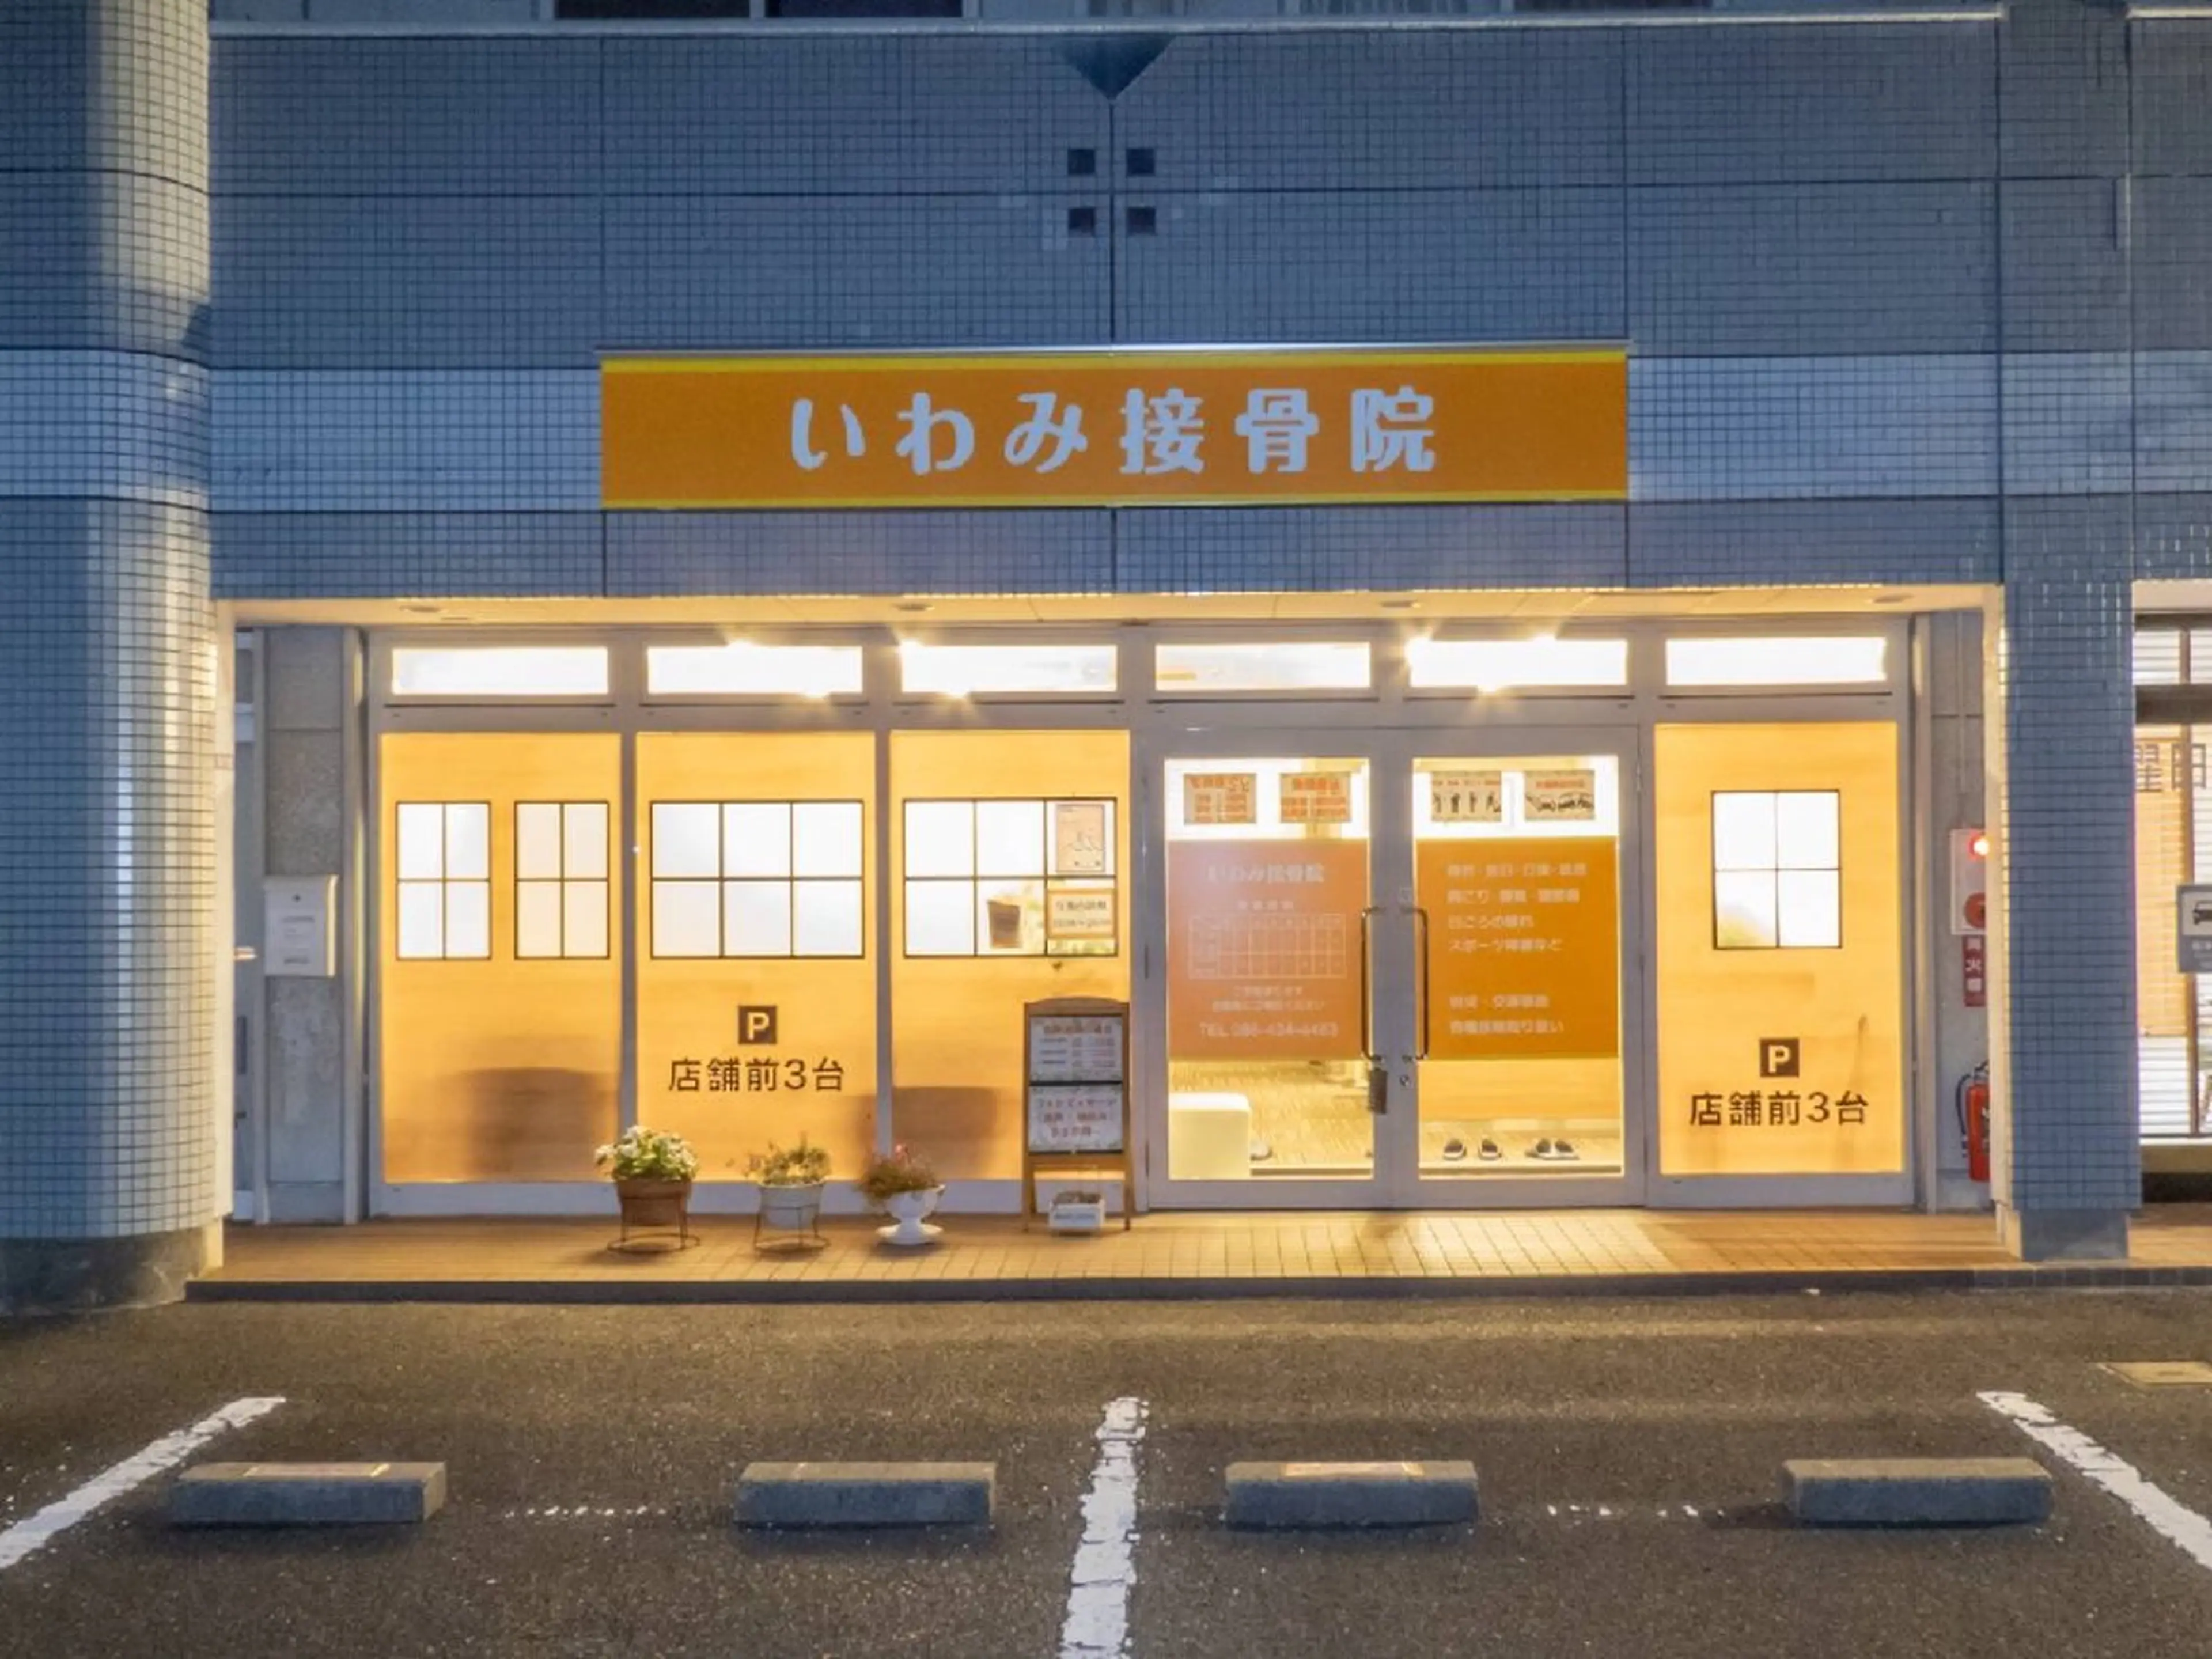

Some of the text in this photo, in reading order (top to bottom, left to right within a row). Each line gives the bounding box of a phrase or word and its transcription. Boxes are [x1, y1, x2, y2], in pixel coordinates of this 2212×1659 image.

[790, 387, 1436, 475] いわみ接骨院
[668, 1056, 844, 1092] 店舗前3台
[1690, 1090, 1869, 1126] 店舗前3台
